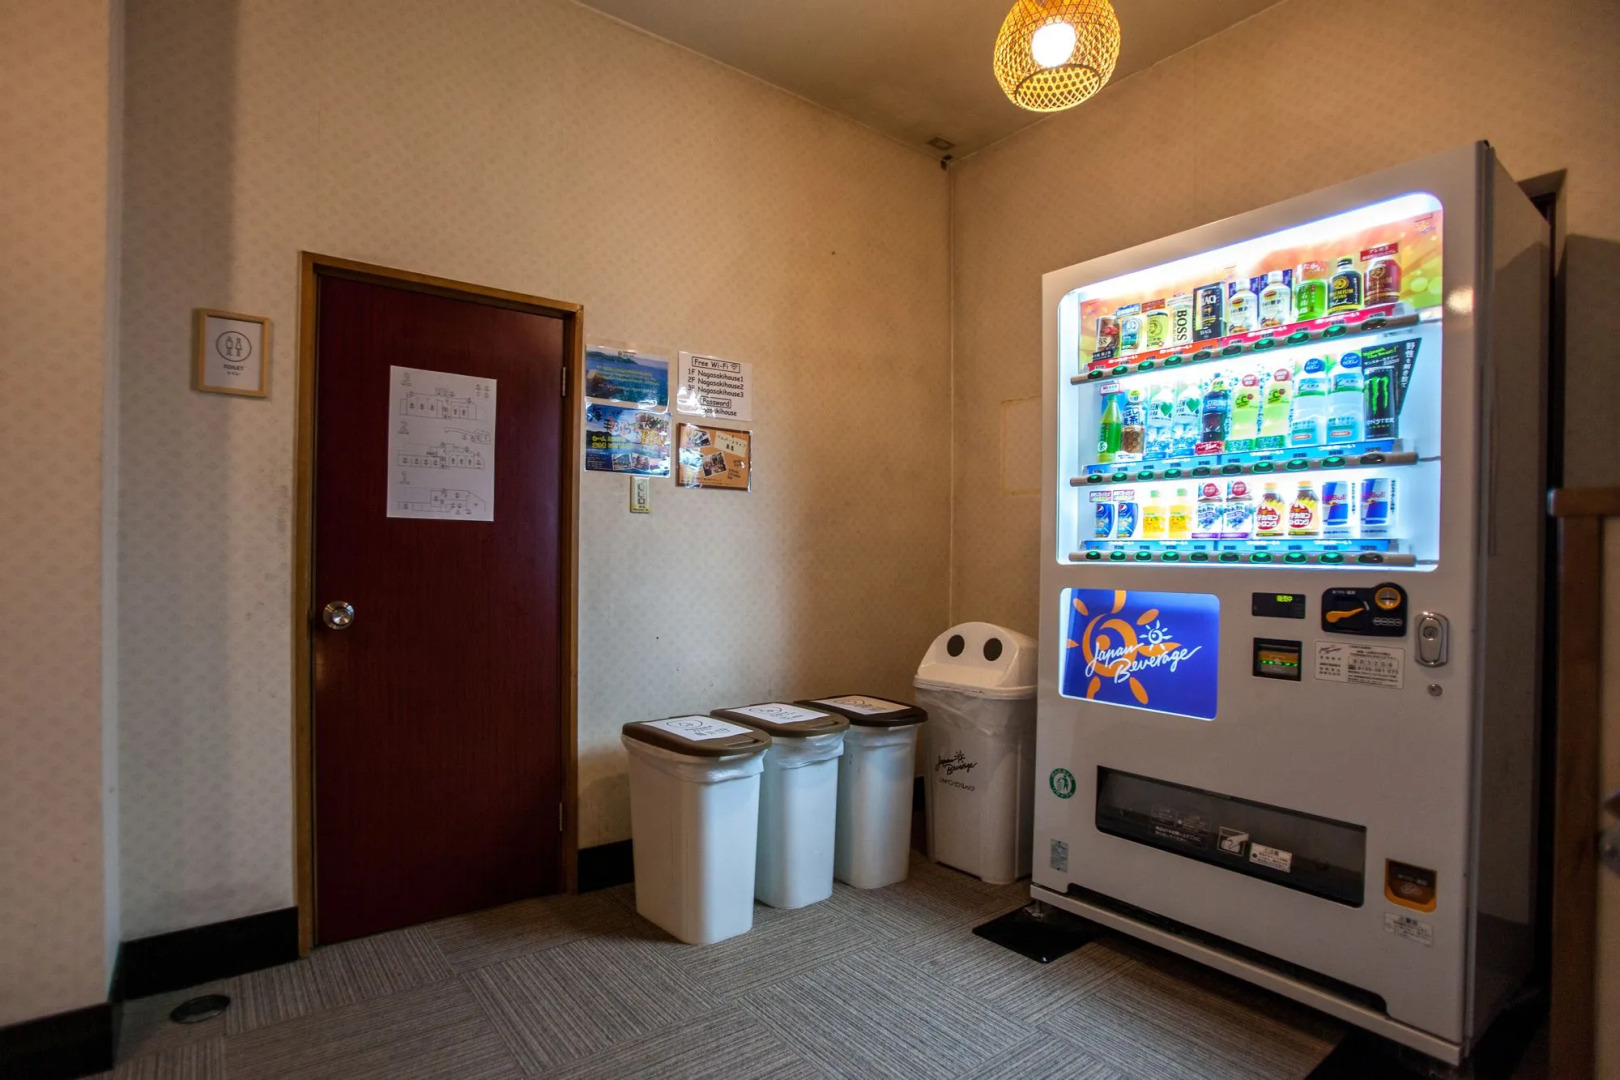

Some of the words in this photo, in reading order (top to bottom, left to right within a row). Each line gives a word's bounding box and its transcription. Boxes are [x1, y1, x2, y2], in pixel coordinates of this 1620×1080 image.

[1176, 310, 1188, 341] BOSS
[223, 363, 244, 371] TOILET
[694, 358, 709, 367] Free
[711, 361, 729, 370] Wi-Fi
[697, 370, 744, 382] Nagasakihouse1
[697, 378, 744, 390] Nagasakihouse2
[697, 386, 744, 398] Nagasakihouse3
[702, 397, 730, 407] Password
[1085, 642, 1144, 677] Japan
[1109, 646, 1202, 684] Beverage
